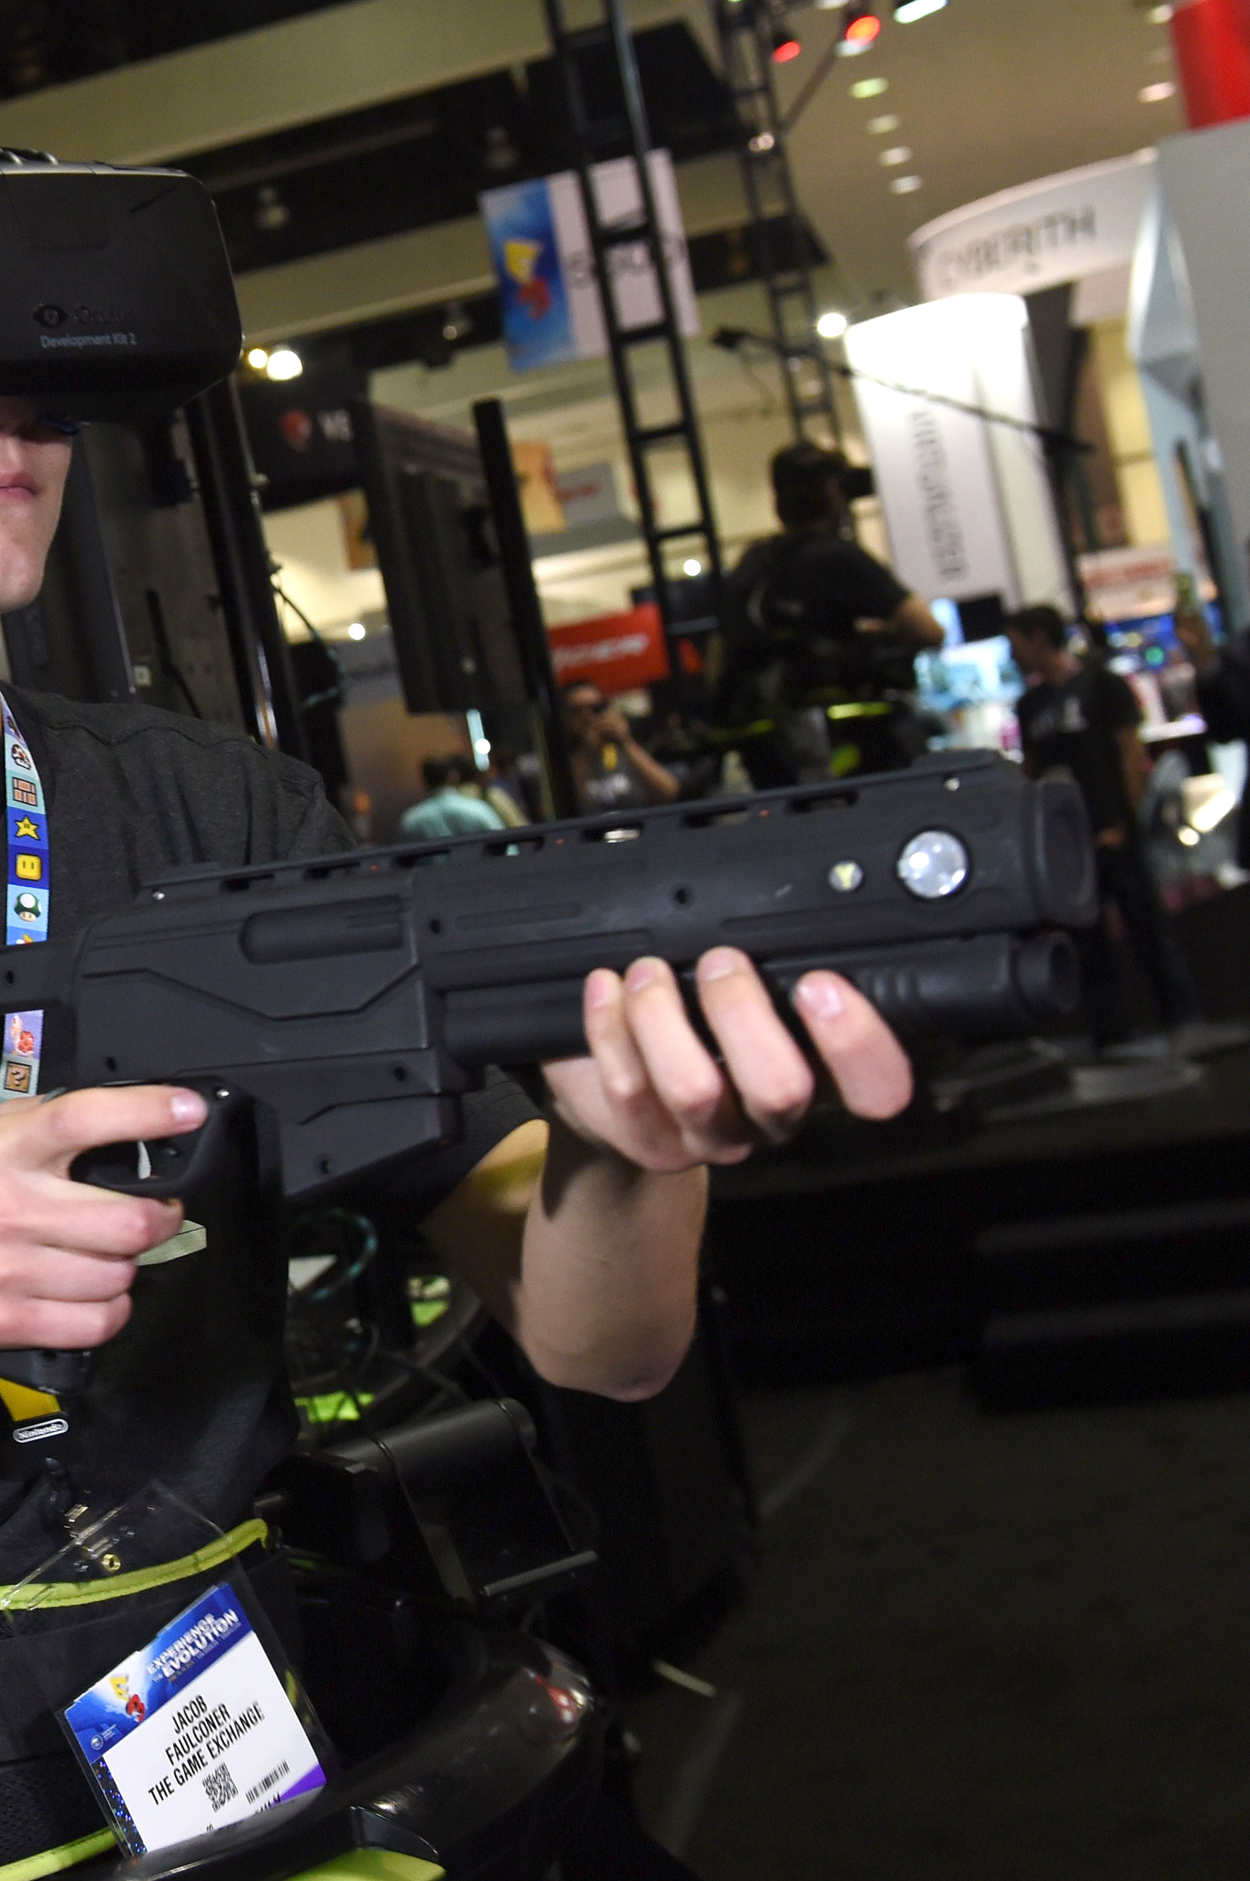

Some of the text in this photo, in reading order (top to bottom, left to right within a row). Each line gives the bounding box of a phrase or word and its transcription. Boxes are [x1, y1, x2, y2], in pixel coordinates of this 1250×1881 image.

[39, 332, 137, 349] Development Kit 2
[146, 1613, 215, 1675] EXPERIENCE
[161, 1608, 239, 1678] EVOLUTION
[165, 1703, 231, 1766] FAULCONER
[172, 1694, 208, 1734] JACOB
[148, 1701, 265, 1805] THE GAME EXCHANGE
